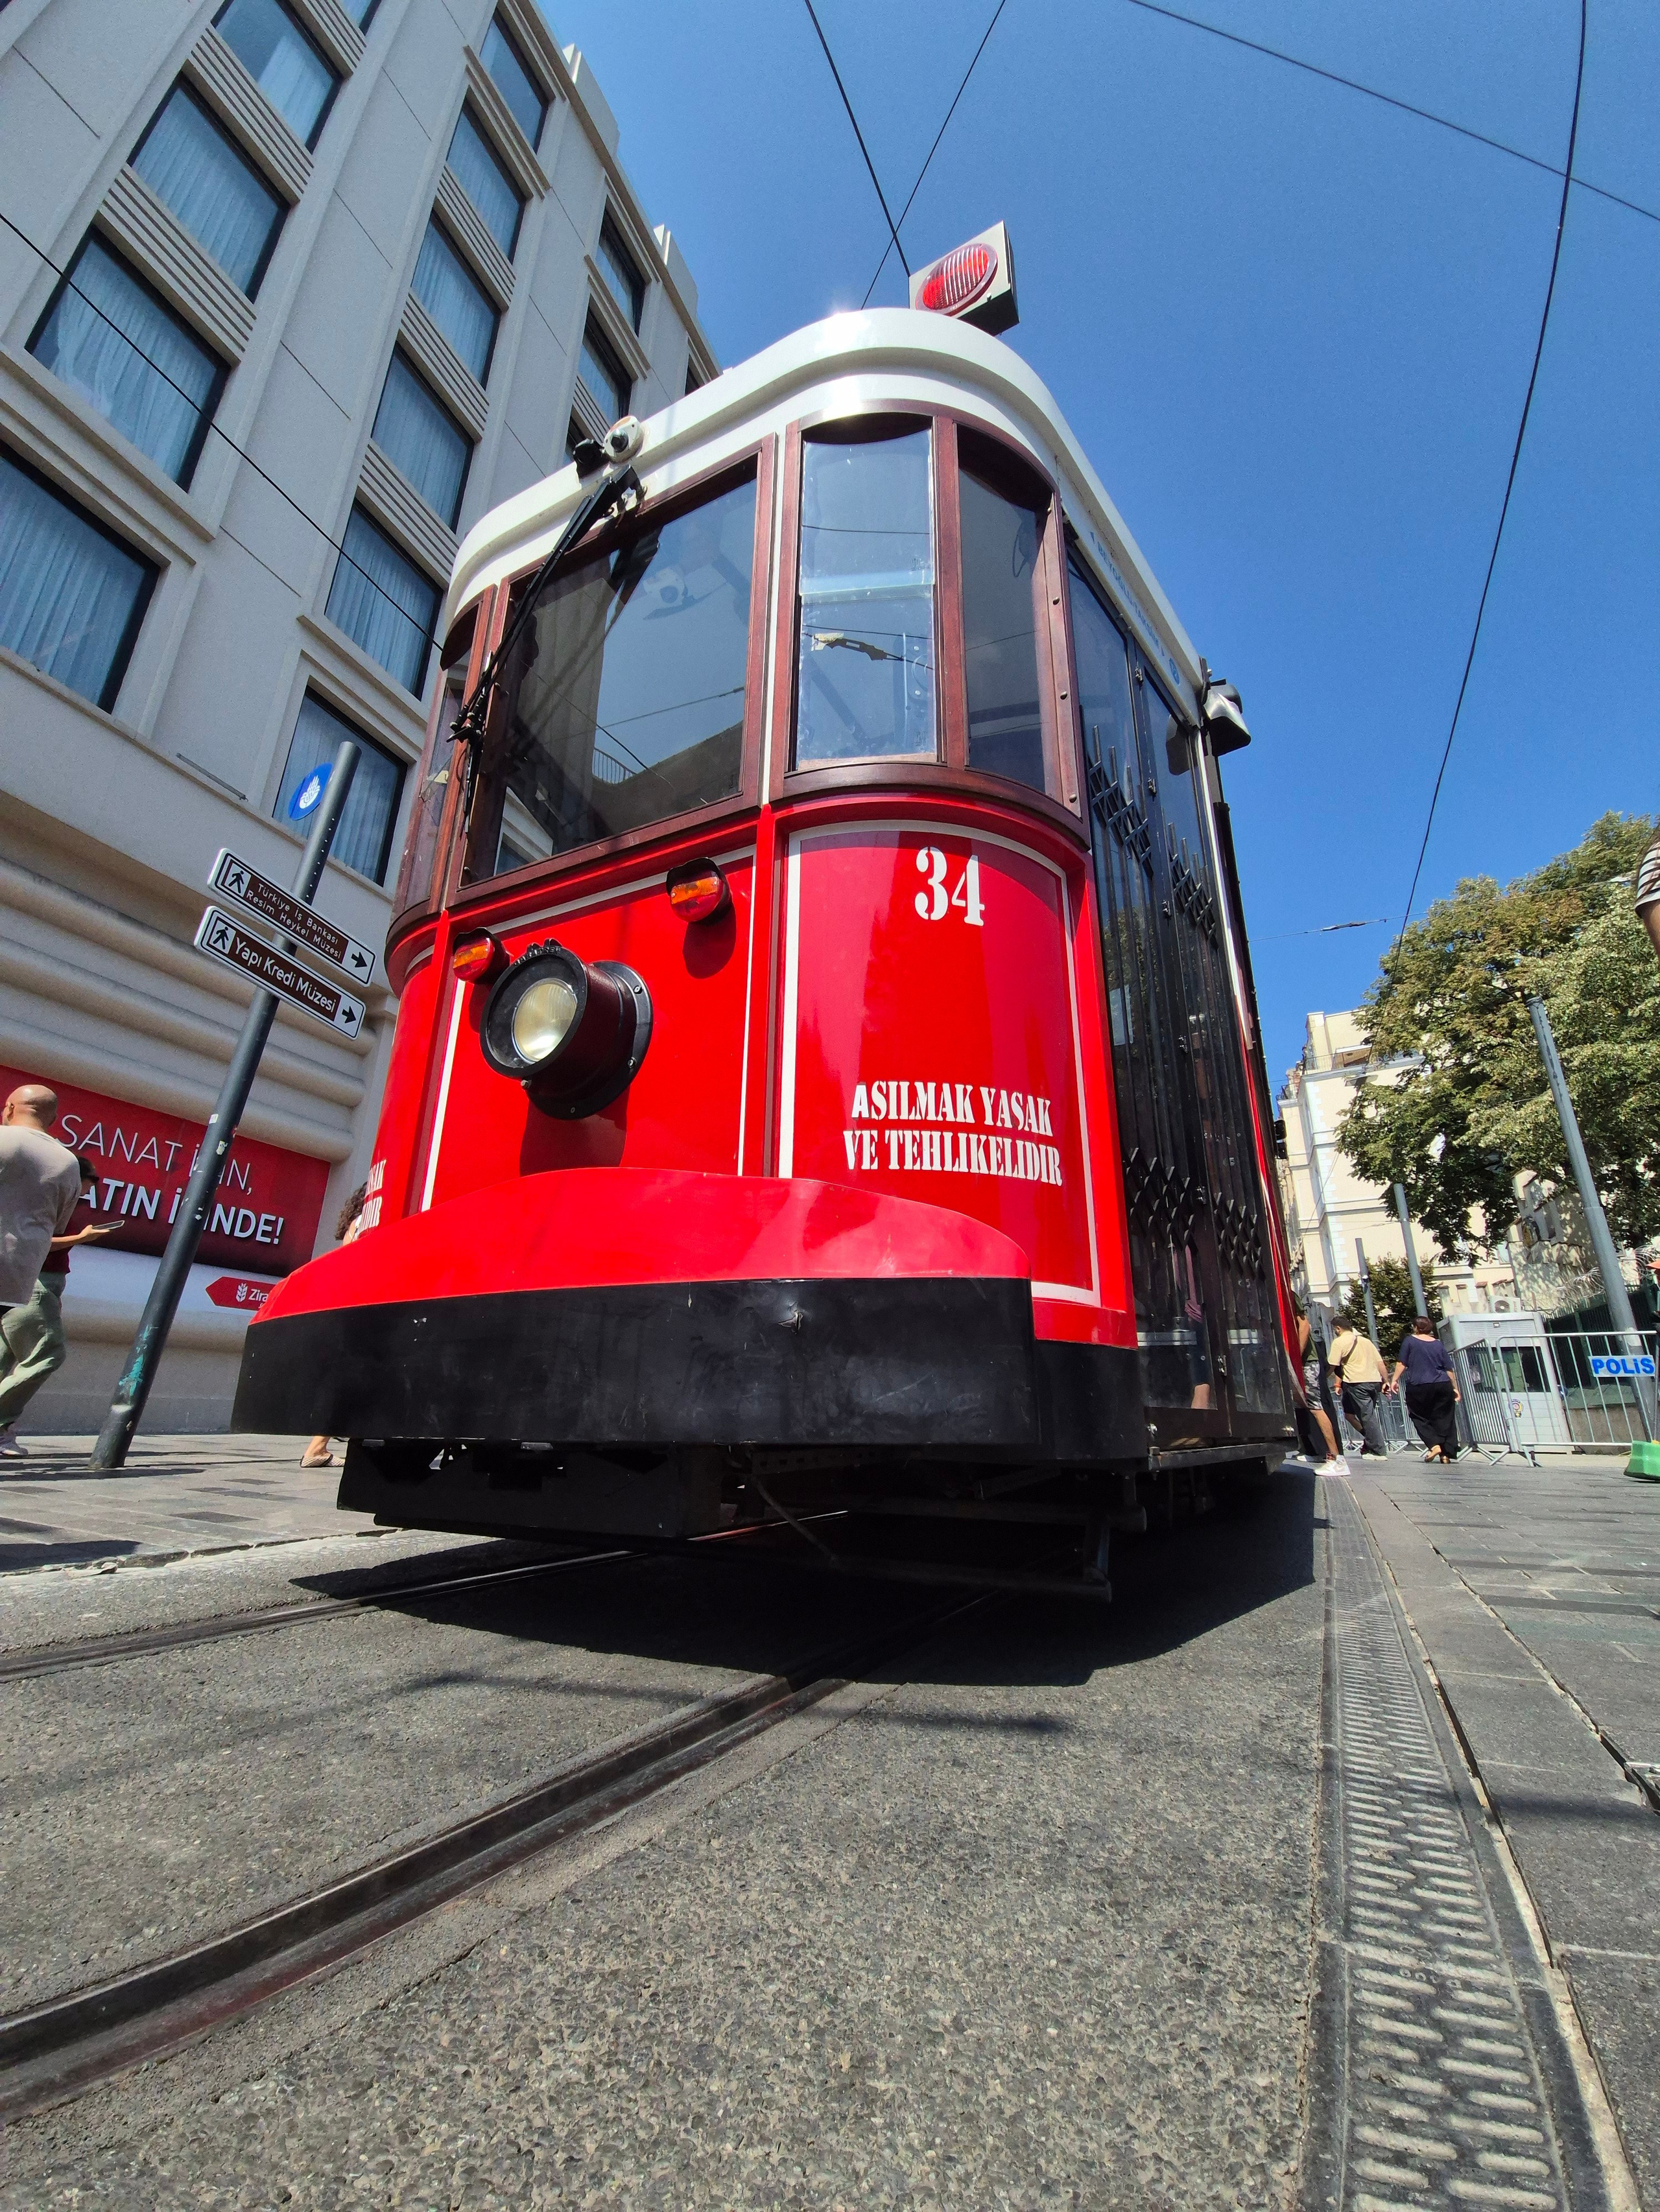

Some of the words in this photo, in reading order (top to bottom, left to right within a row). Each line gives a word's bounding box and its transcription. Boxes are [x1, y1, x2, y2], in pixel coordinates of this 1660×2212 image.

[258, 884, 290, 912] Türkiye
[294, 908, 303, 921] İş
[307, 917, 338, 944] Bankası
[915, 847, 985, 926] 34
[246, 890, 274, 915] Resim
[279, 912, 309, 937] Heykel
[313, 934, 341, 959] Müzesi
[235, 937, 263, 967] Yapı
[263, 957, 296, 987] Kredi
[296, 977, 336, 1013] Müzesi
[851, 1081, 975, 1124] ASILMAK
[980, 1087, 1053, 1136] YASAK
[56, 1114, 183, 1171] SANAT
[844, 1130, 878, 1170] VE
[885, 1130, 1062, 1186] TEHLIKELIDIR
